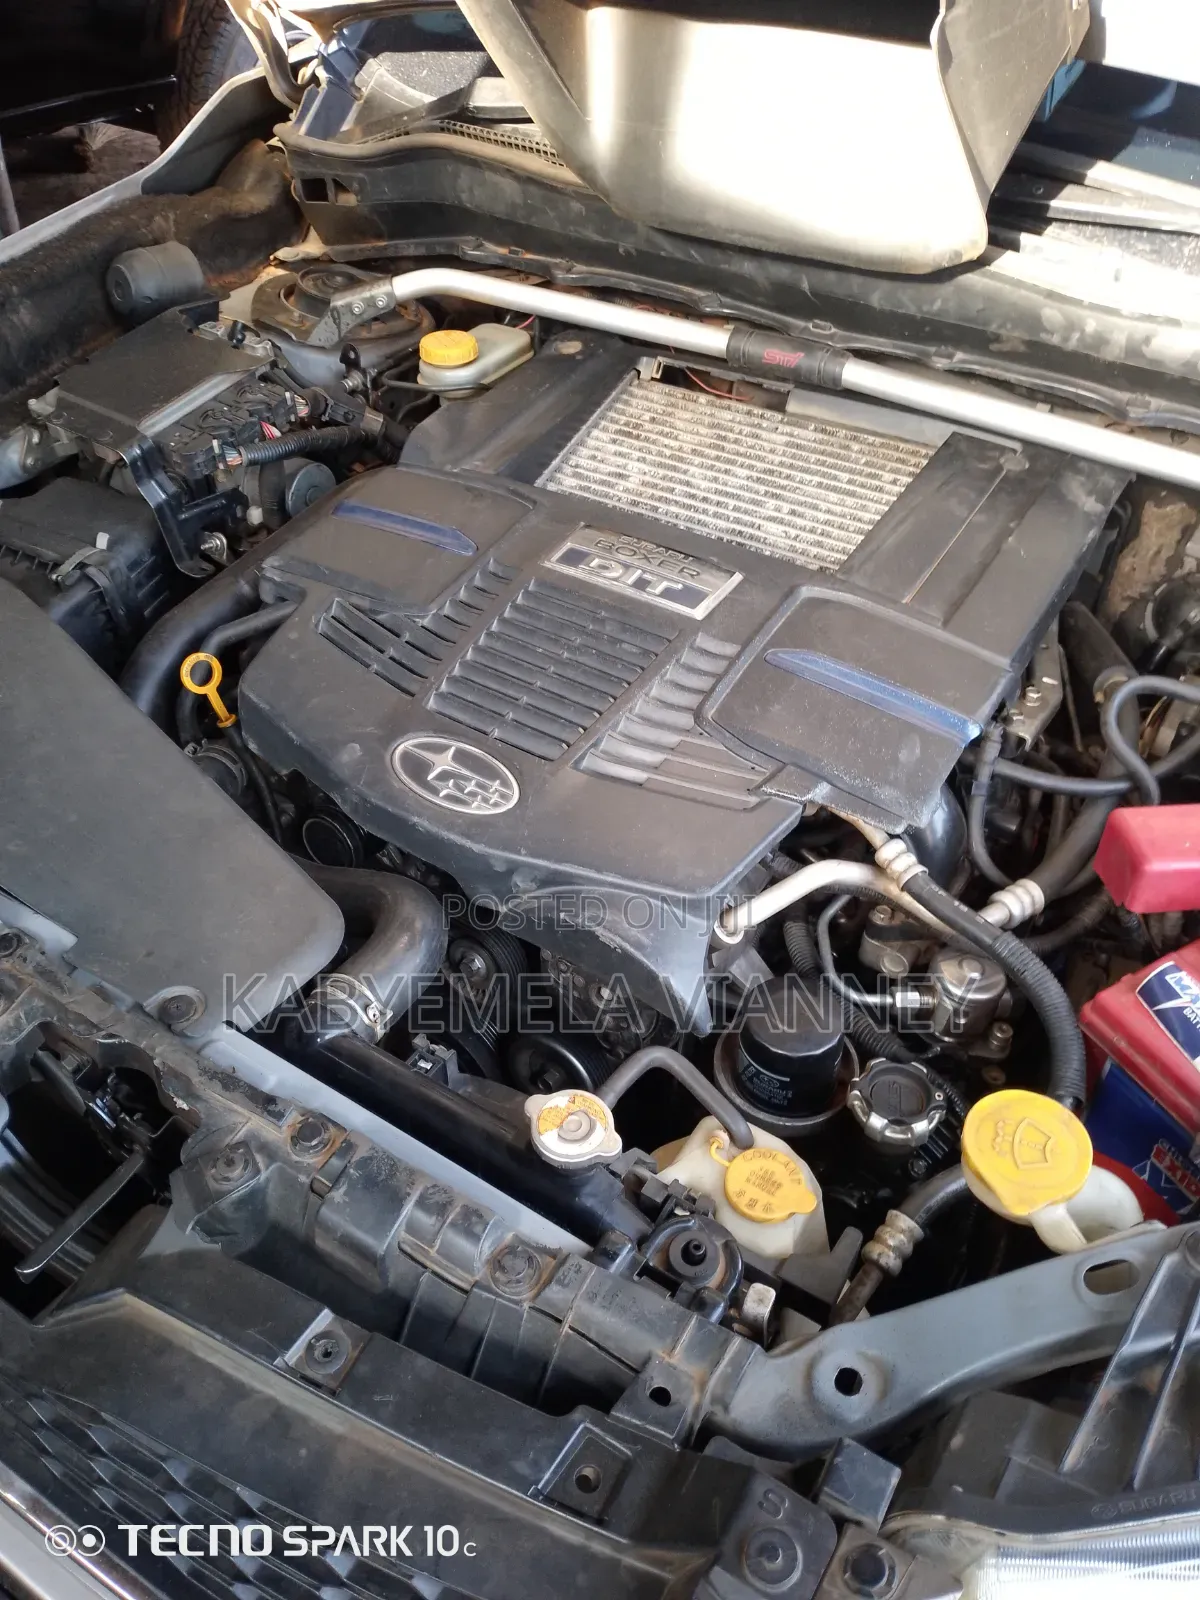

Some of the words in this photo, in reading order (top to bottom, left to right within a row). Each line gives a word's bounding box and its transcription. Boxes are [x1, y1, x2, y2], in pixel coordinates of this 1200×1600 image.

[578, 557, 684, 596] DIT
[594, 538, 702, 579] BOXER
[743, 1150, 802, 1186] COOLANT
